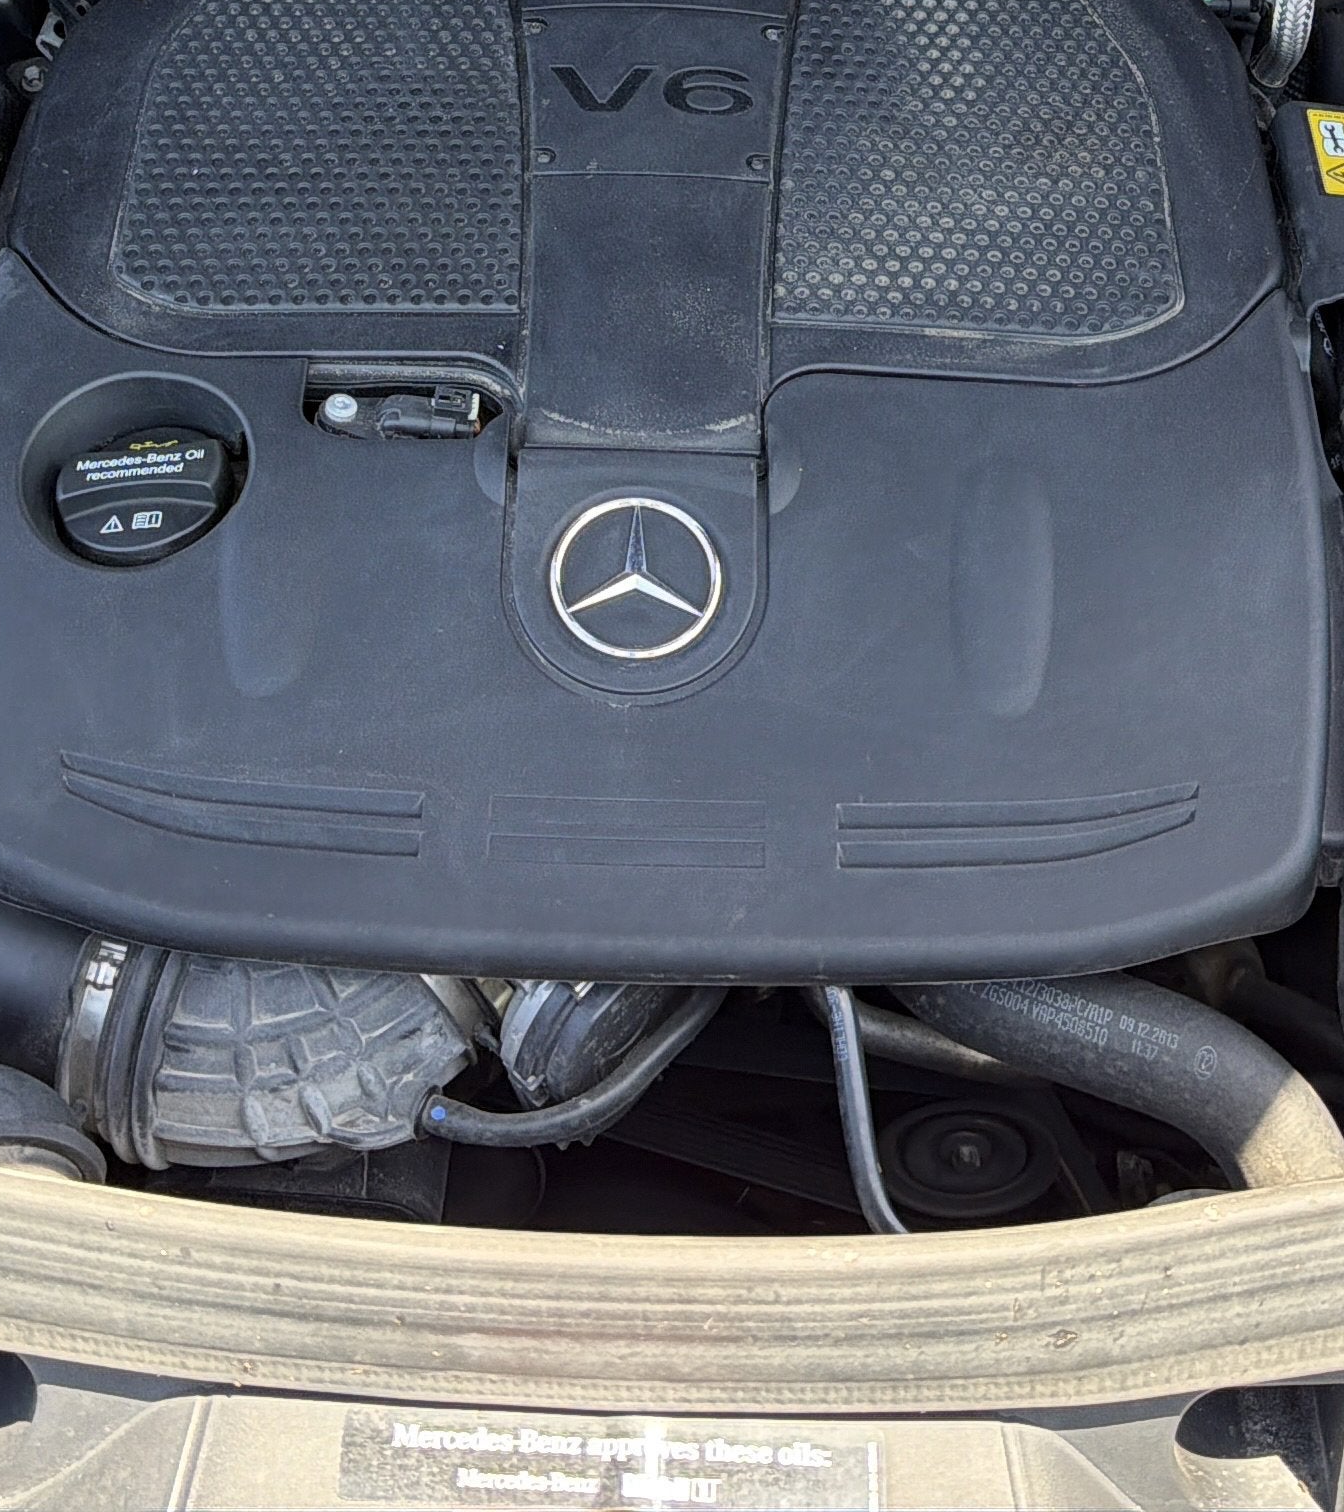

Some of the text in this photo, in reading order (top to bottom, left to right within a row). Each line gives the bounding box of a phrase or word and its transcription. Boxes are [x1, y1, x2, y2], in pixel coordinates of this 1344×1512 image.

[549, 64, 754, 116] V6
[76, 449, 205, 471] Mercedes-Benz Oil
[86, 462, 184, 481] recommended
[391, 1422, 833, 1467] Mercedes-Benz apprves these oils:
